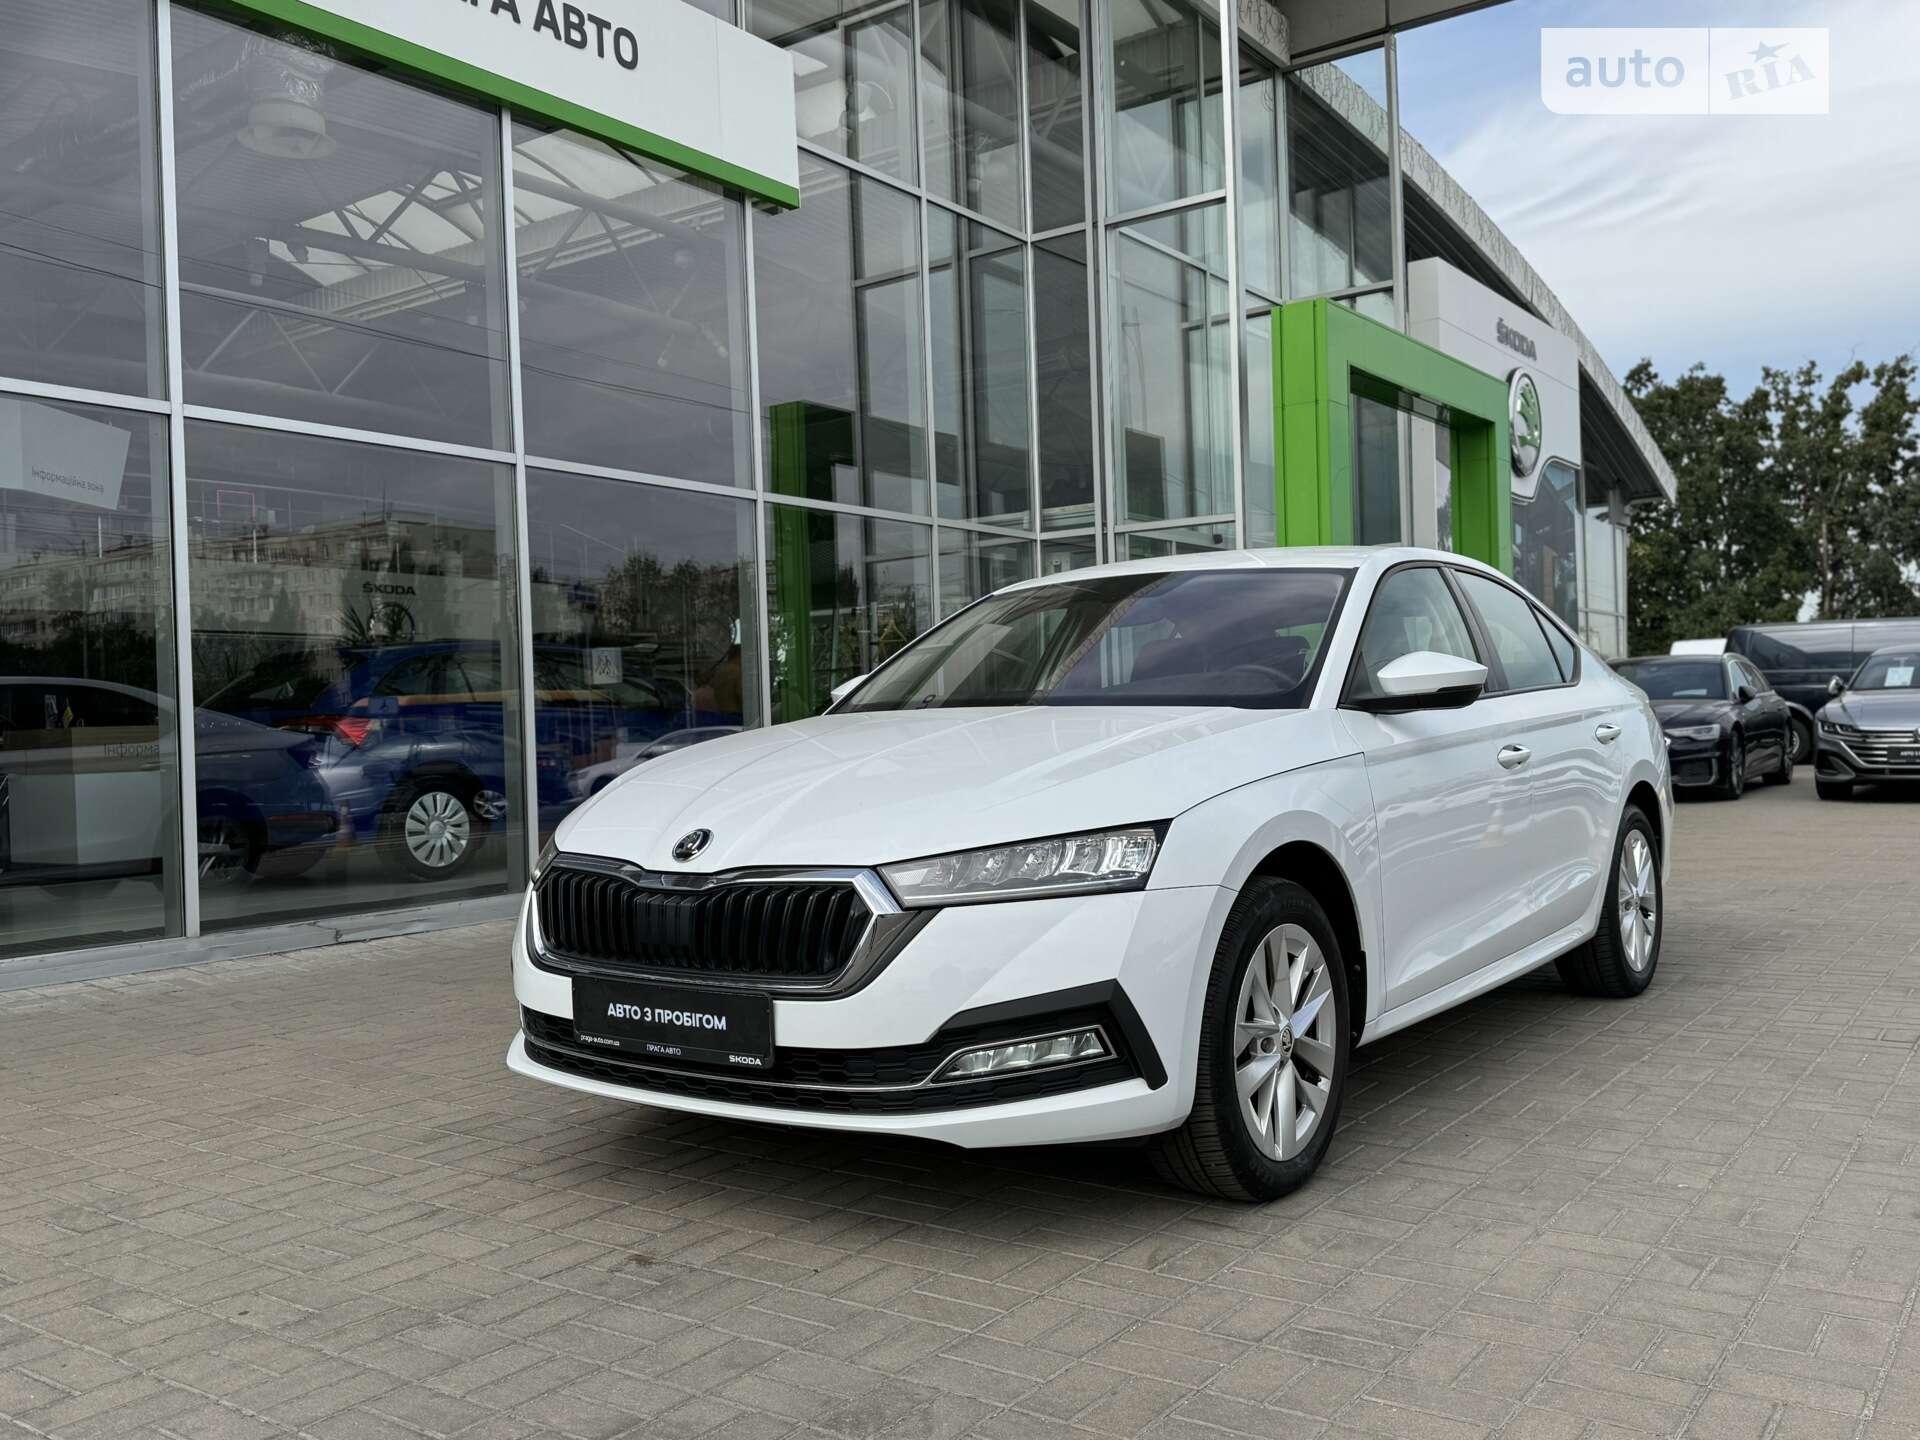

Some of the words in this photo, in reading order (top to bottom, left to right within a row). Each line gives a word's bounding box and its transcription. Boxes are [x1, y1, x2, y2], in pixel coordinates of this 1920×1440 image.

[533, 0, 639, 70] АВТО
[607, 1002, 641, 1020] АВТО
[654, 1009, 726, 1031] ПРОБІГОМ
[580, 1034, 620, 1047] praga-auto.com.ua
[646, 1044, 665, 1054] ПРАГА
[665, 1045, 682, 1056] АВТО
